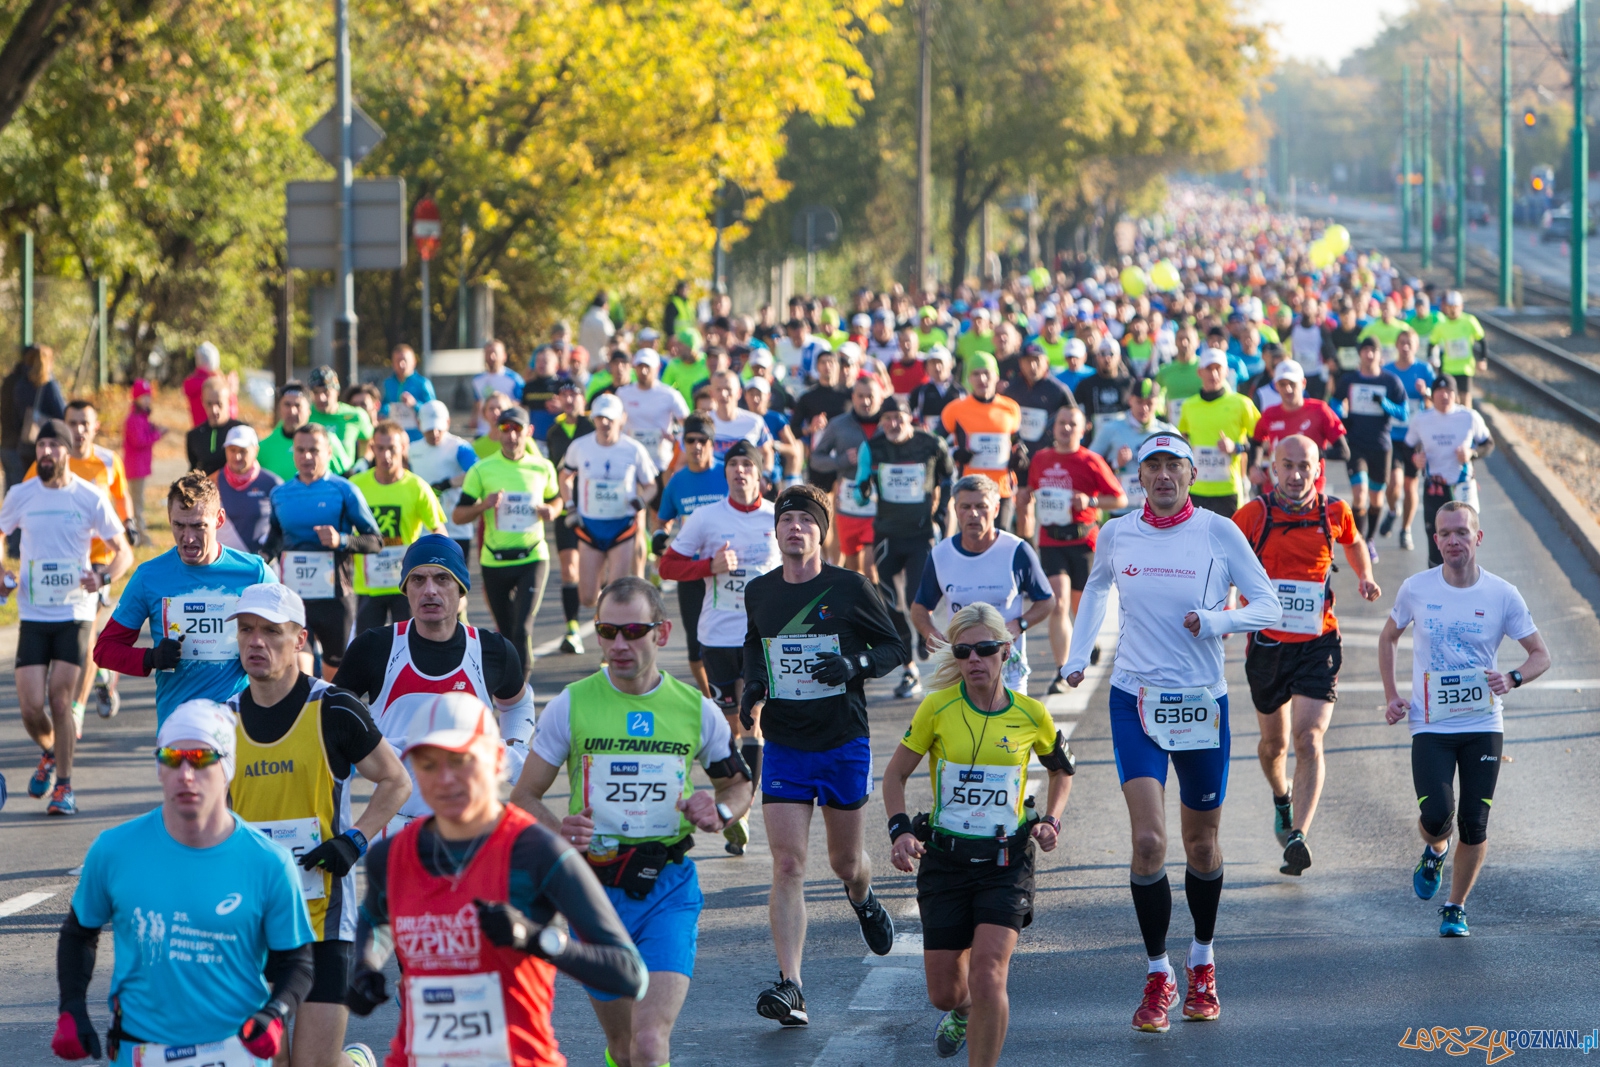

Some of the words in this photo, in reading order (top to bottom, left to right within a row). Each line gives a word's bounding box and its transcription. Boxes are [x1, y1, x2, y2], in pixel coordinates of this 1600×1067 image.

[41, 574, 73, 586] 4861
[296, 567, 317, 579] 917
[724, 580, 745, 592] 42
[185, 618, 223, 633] 2611
[780, 658, 826, 674] 526
[1438, 687, 1482, 705] 3320
[1154, 707, 1208, 724] 6360
[584, 738, 691, 755] UNI-TANKERS
[606, 782, 667, 802] 2575
[953, 787, 1008, 806] 5670
[170, 938, 214, 951] PHILIPS
[424, 1012, 492, 1040] 7251
